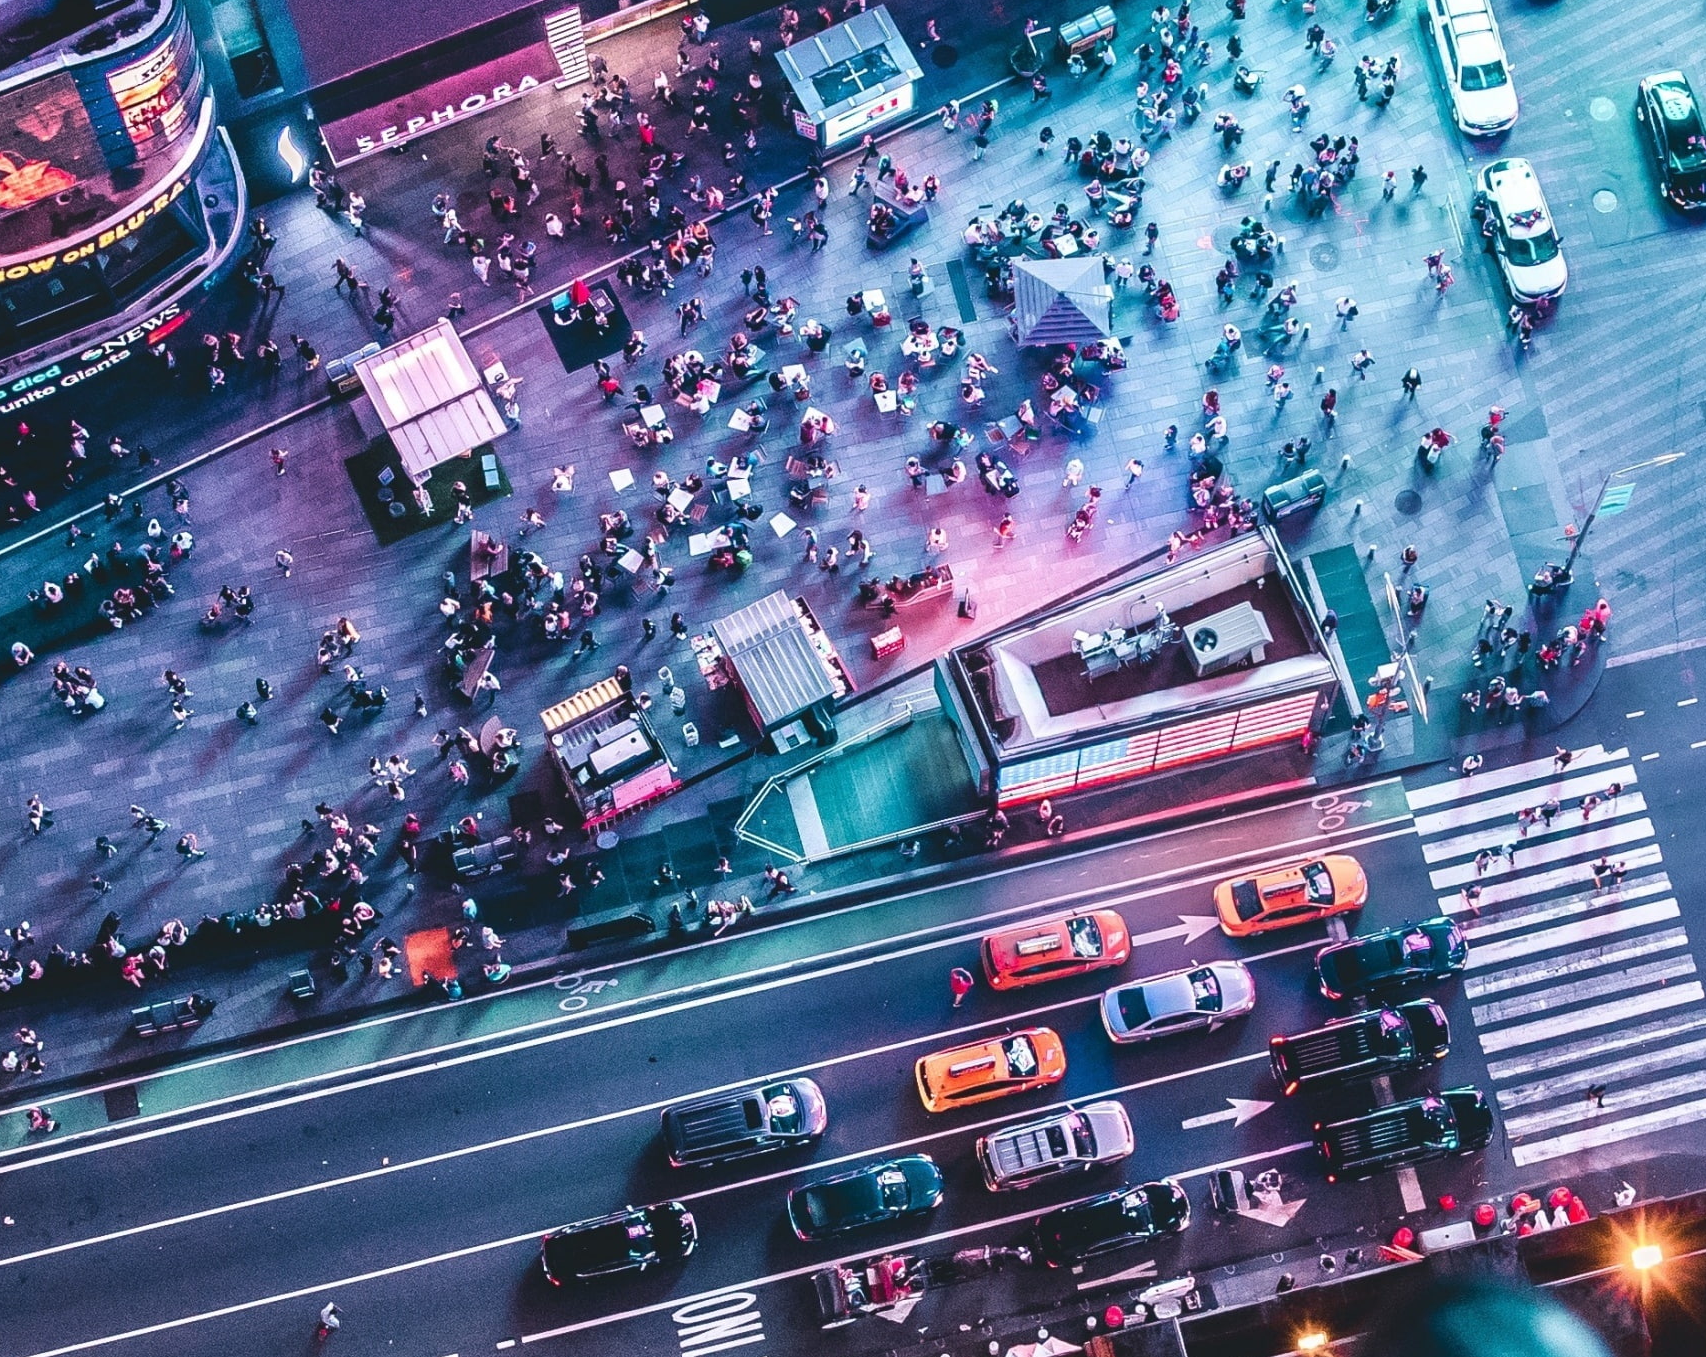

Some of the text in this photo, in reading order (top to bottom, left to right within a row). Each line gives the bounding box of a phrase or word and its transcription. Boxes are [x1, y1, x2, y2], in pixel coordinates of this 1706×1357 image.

[356, 71, 542, 154] SEPHORA
[63, 242, 96, 265] ON
[101, 303, 181, 355] NEWS
[0, 385, 57, 414] unite
[60, 349, 132, 389] Giants
[12, 365, 63, 393] died
